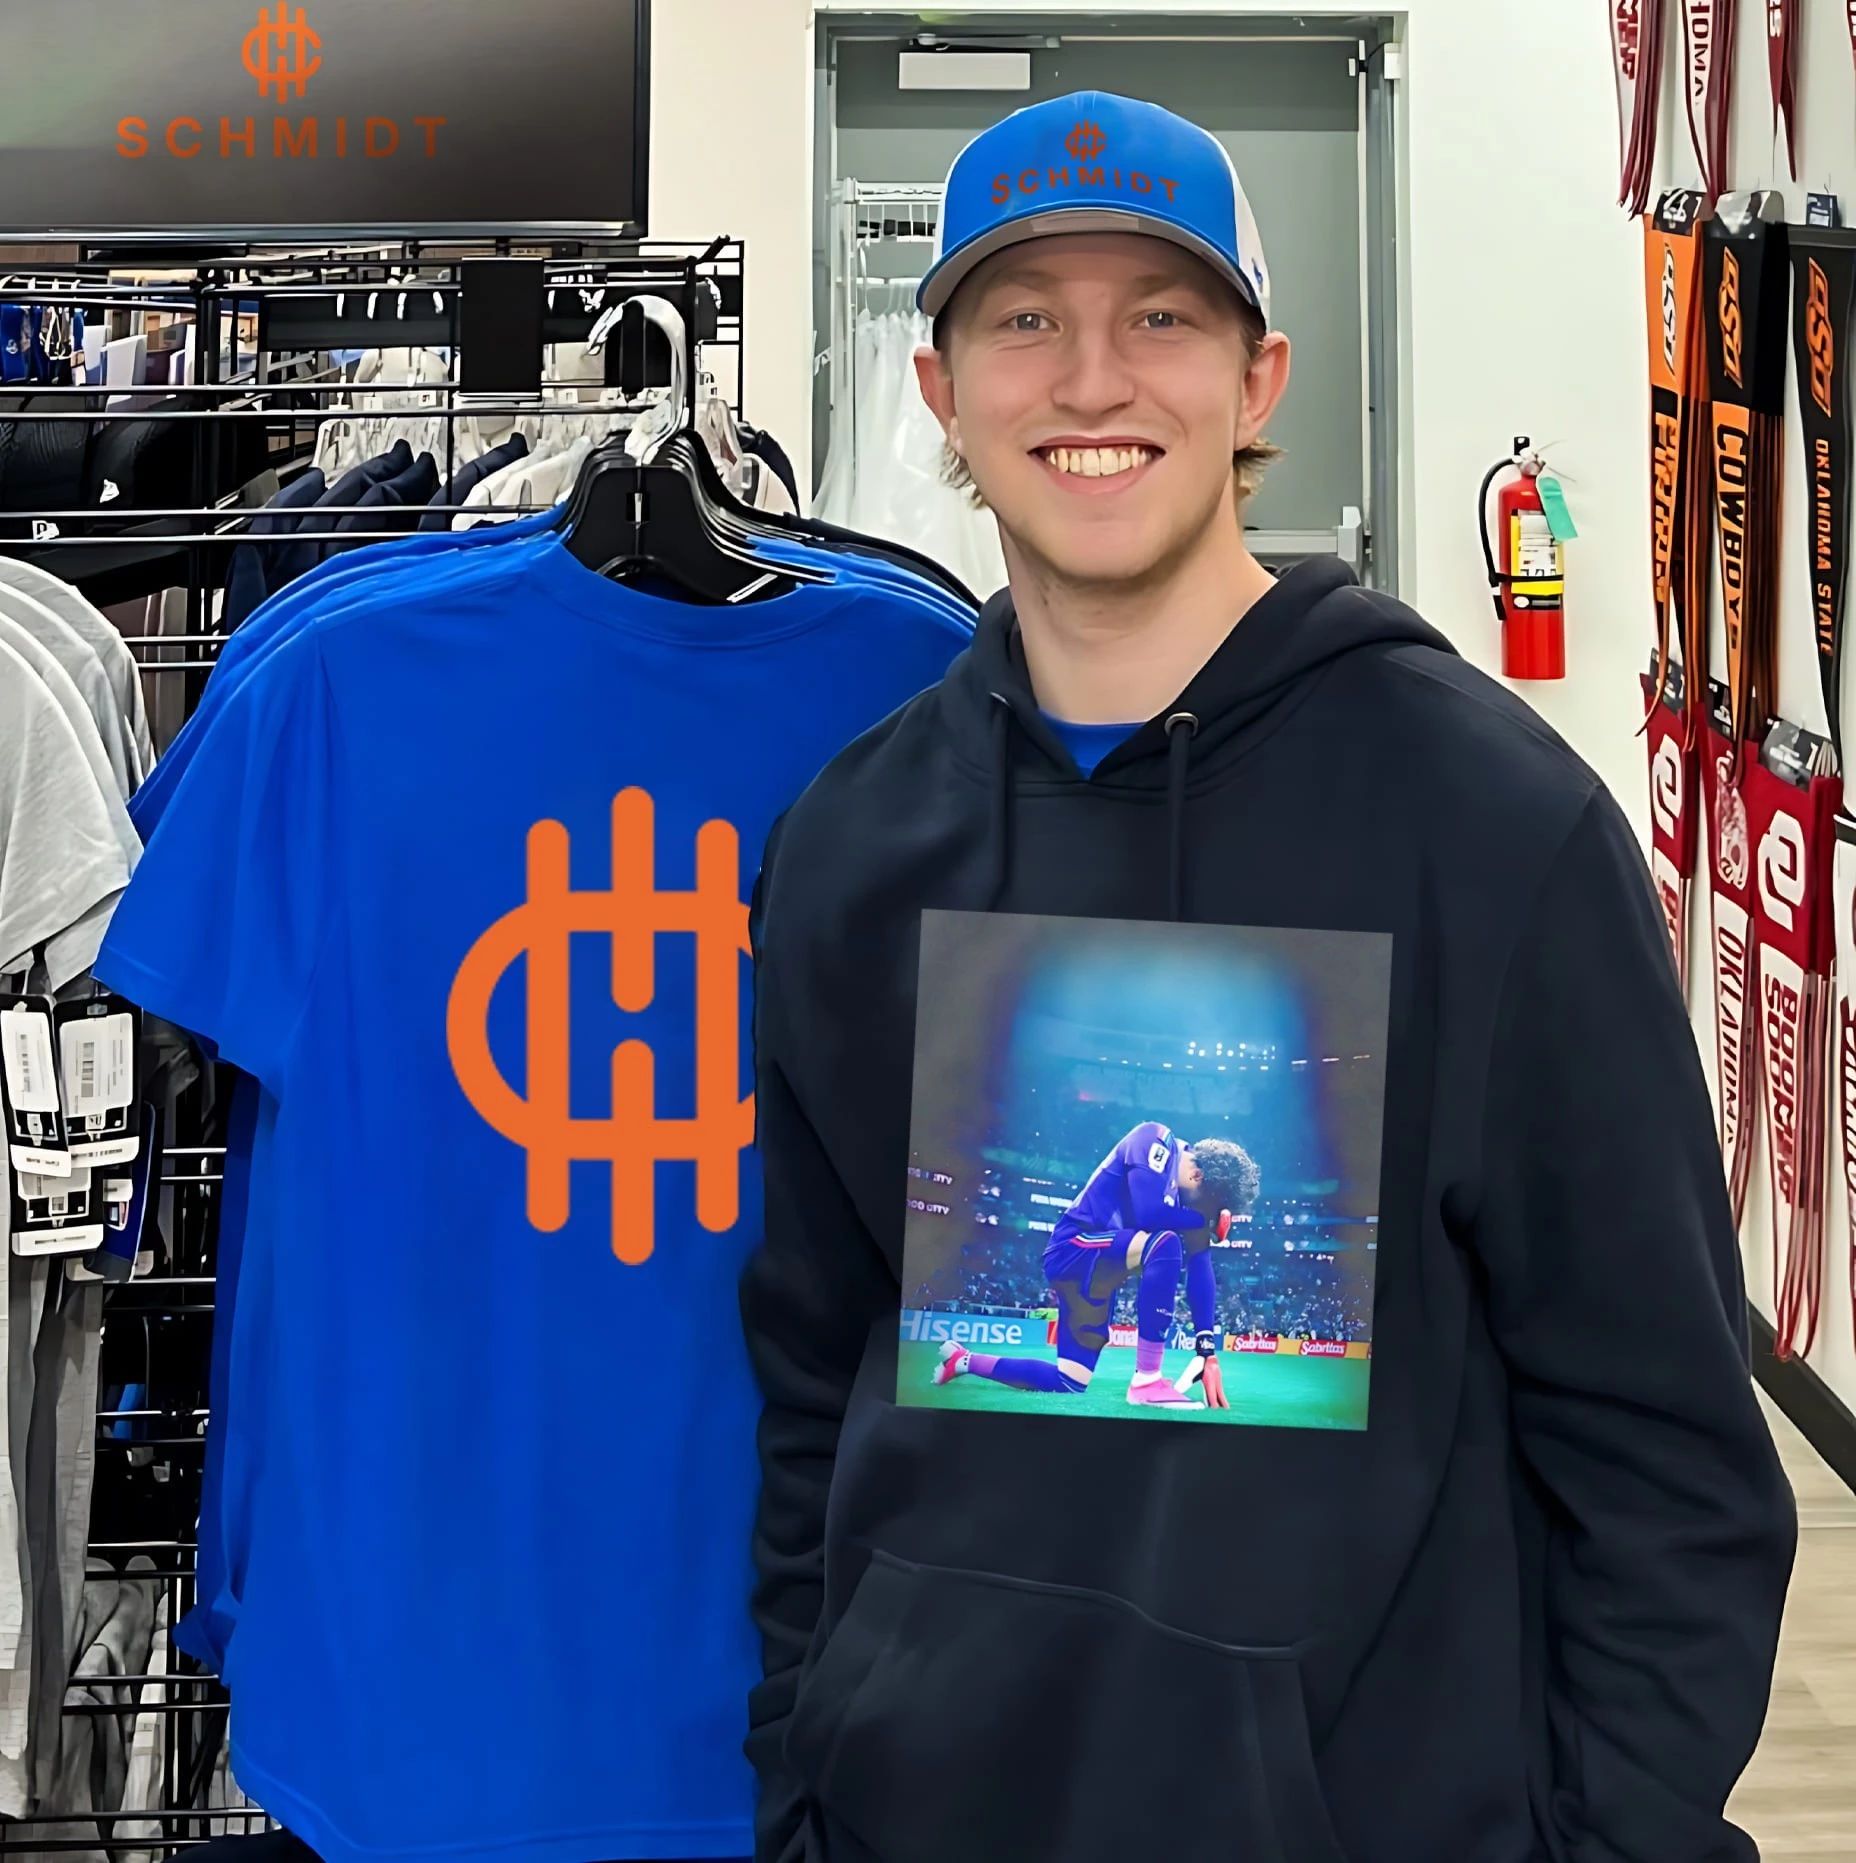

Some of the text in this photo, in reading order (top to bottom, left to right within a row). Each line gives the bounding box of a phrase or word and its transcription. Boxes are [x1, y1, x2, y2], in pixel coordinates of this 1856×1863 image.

[115, 116, 447, 159] SCHMIDT
[991, 167, 1180, 204] SCHMIDT
[900, 1309, 1023, 1345] Hisense
